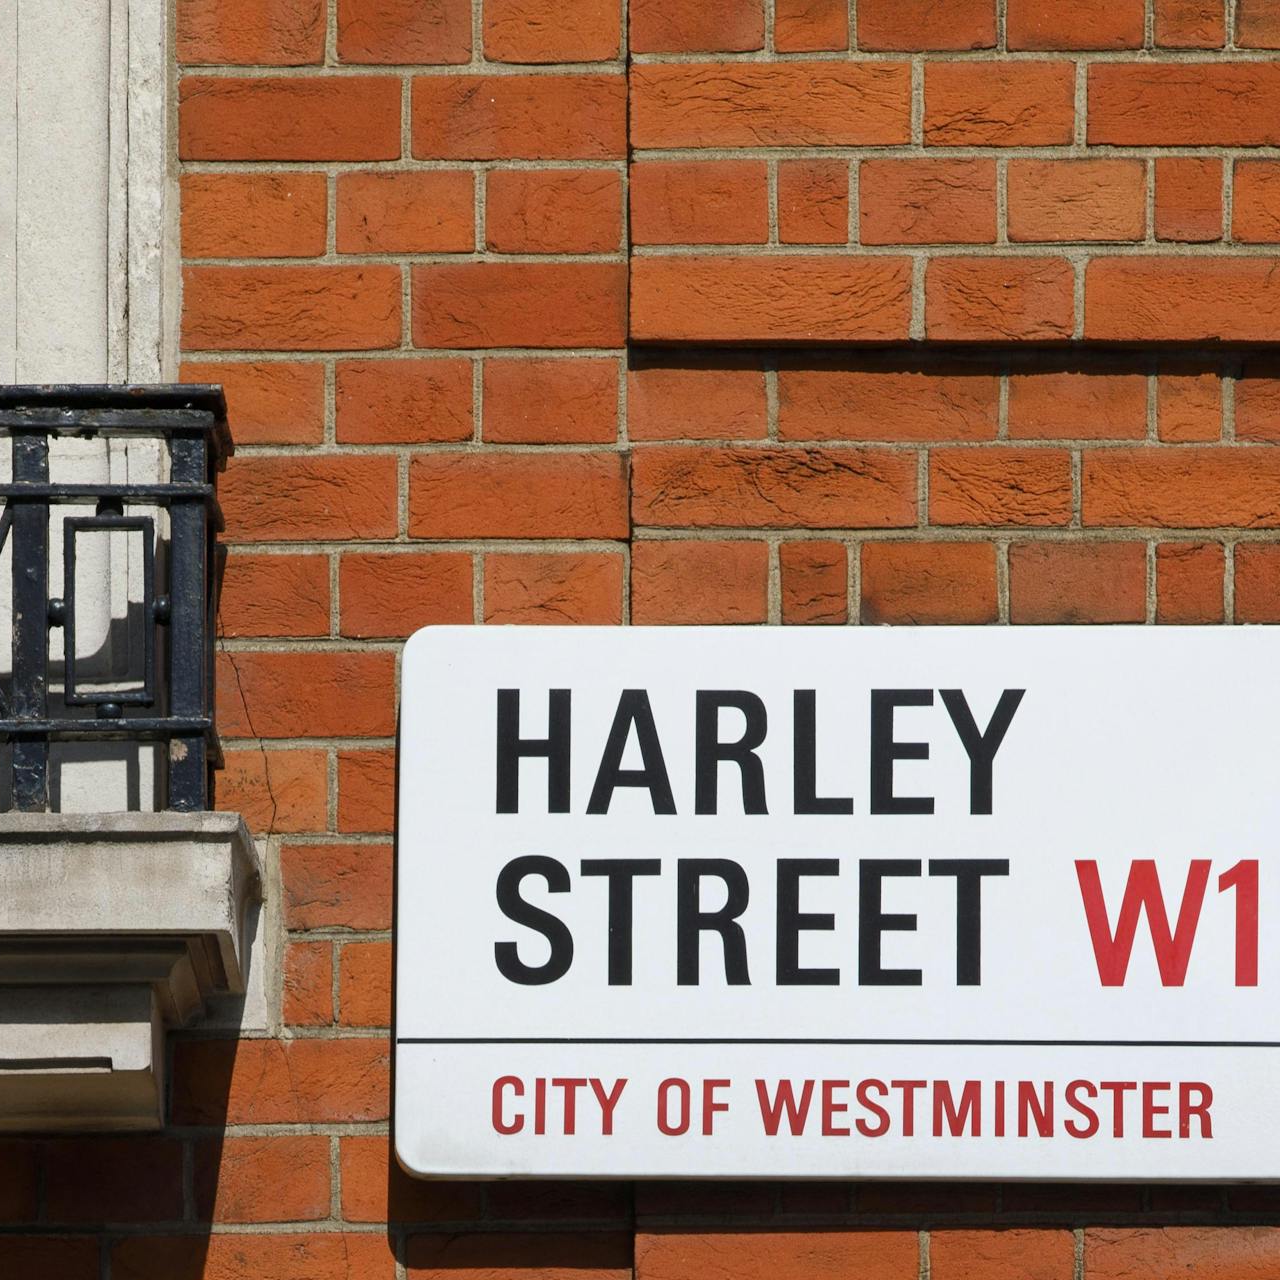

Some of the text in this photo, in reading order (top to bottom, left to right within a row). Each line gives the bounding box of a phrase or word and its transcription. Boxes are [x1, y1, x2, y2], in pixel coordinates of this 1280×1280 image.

[495, 688, 1027, 816] HARLEY
[493, 854, 1260, 988] STREET W1
[491, 1075, 1215, 1140] CITY OF WESTMINSTER
